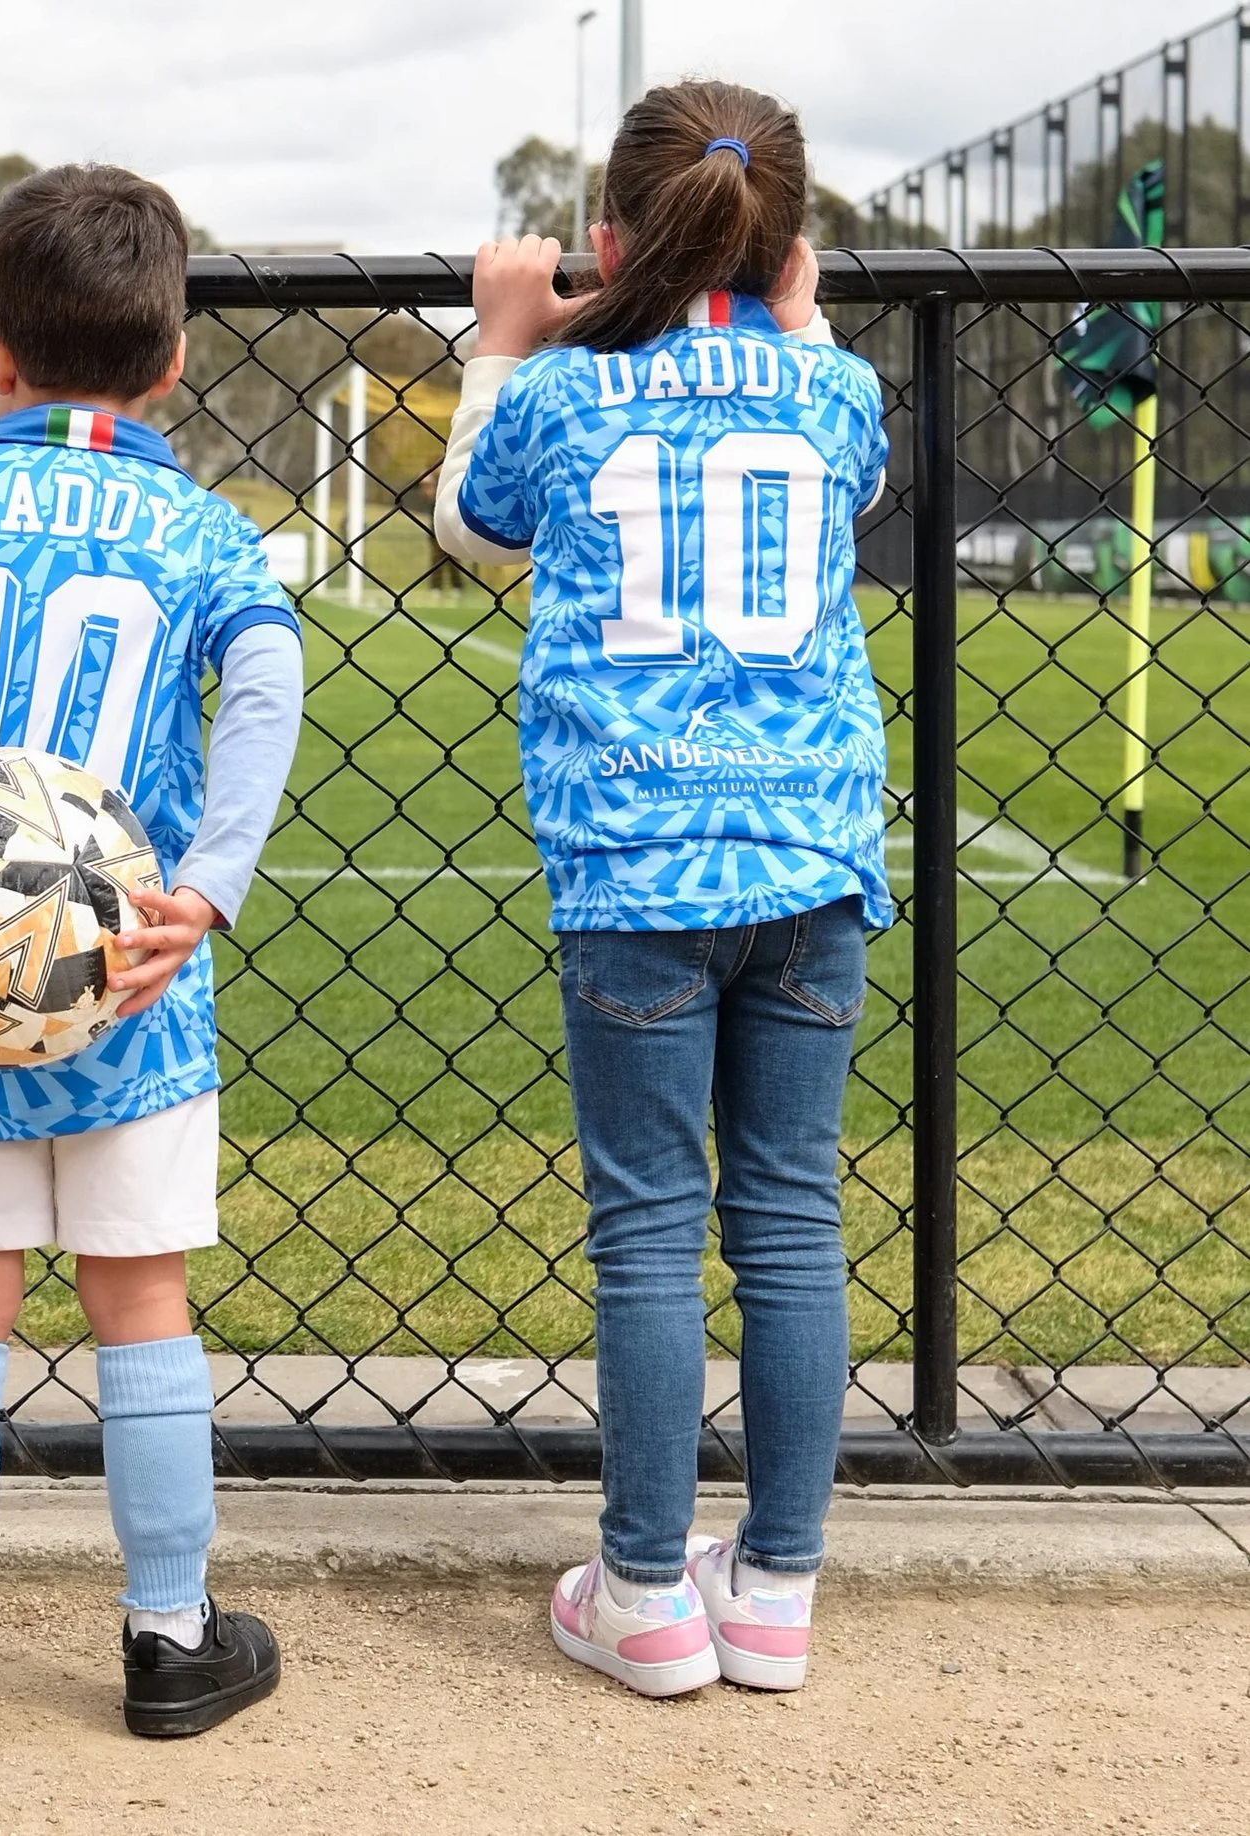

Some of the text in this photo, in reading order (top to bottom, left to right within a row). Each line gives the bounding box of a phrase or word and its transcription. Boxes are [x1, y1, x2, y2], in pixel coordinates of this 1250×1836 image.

[593, 336, 821, 408] DADDY
[590, 433, 837, 670] 10
[600, 742, 664, 777] SAN
[637, 780, 816, 800] MILLENNIUM WATER
